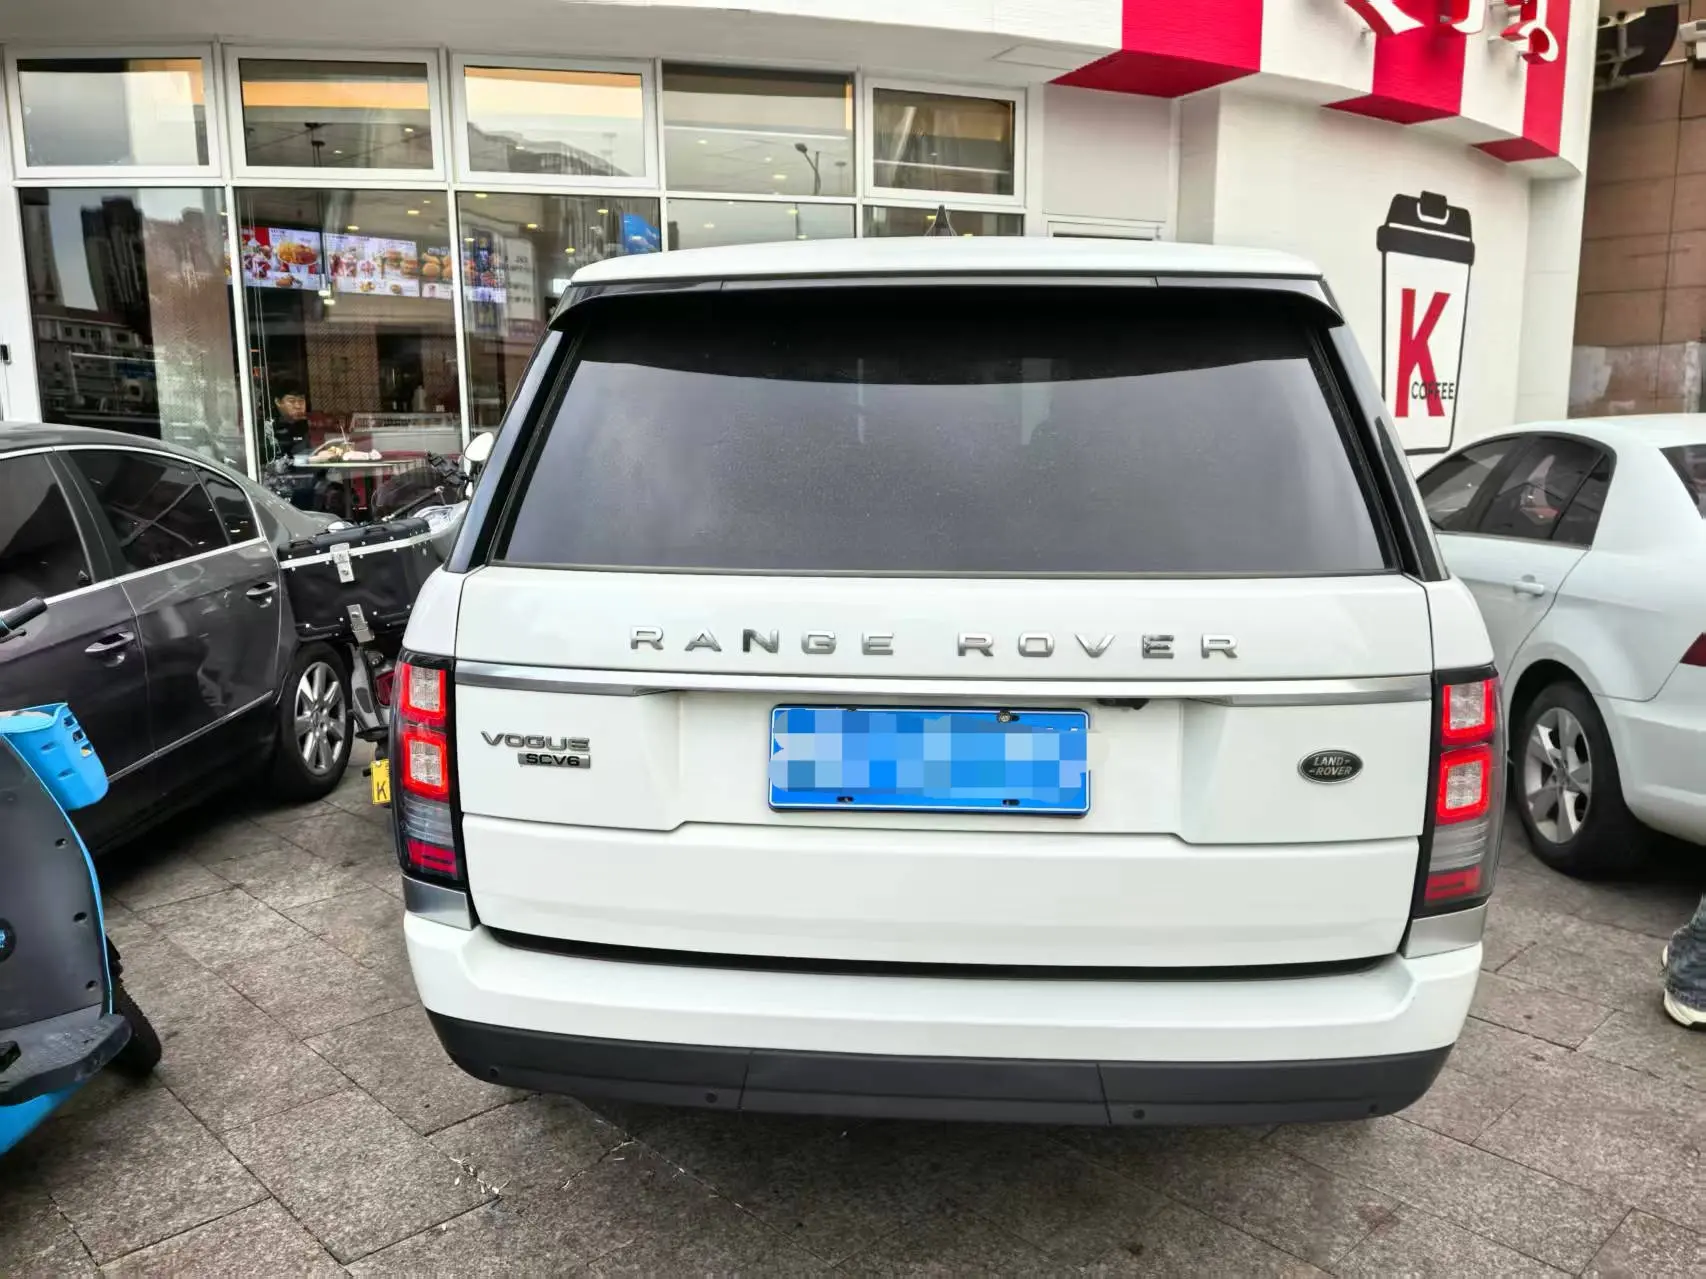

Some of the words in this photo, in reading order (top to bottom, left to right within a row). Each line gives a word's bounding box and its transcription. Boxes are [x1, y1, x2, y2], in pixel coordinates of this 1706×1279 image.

[1395, 287, 1451, 418] K
[1411, 380, 1455, 400] COFFEE
[630, 625, 895, 656] RANGE
[957, 631, 1239, 659] ROVER
[481, 730, 591, 752] VOGUE
[525, 753, 581, 767] SCV6
